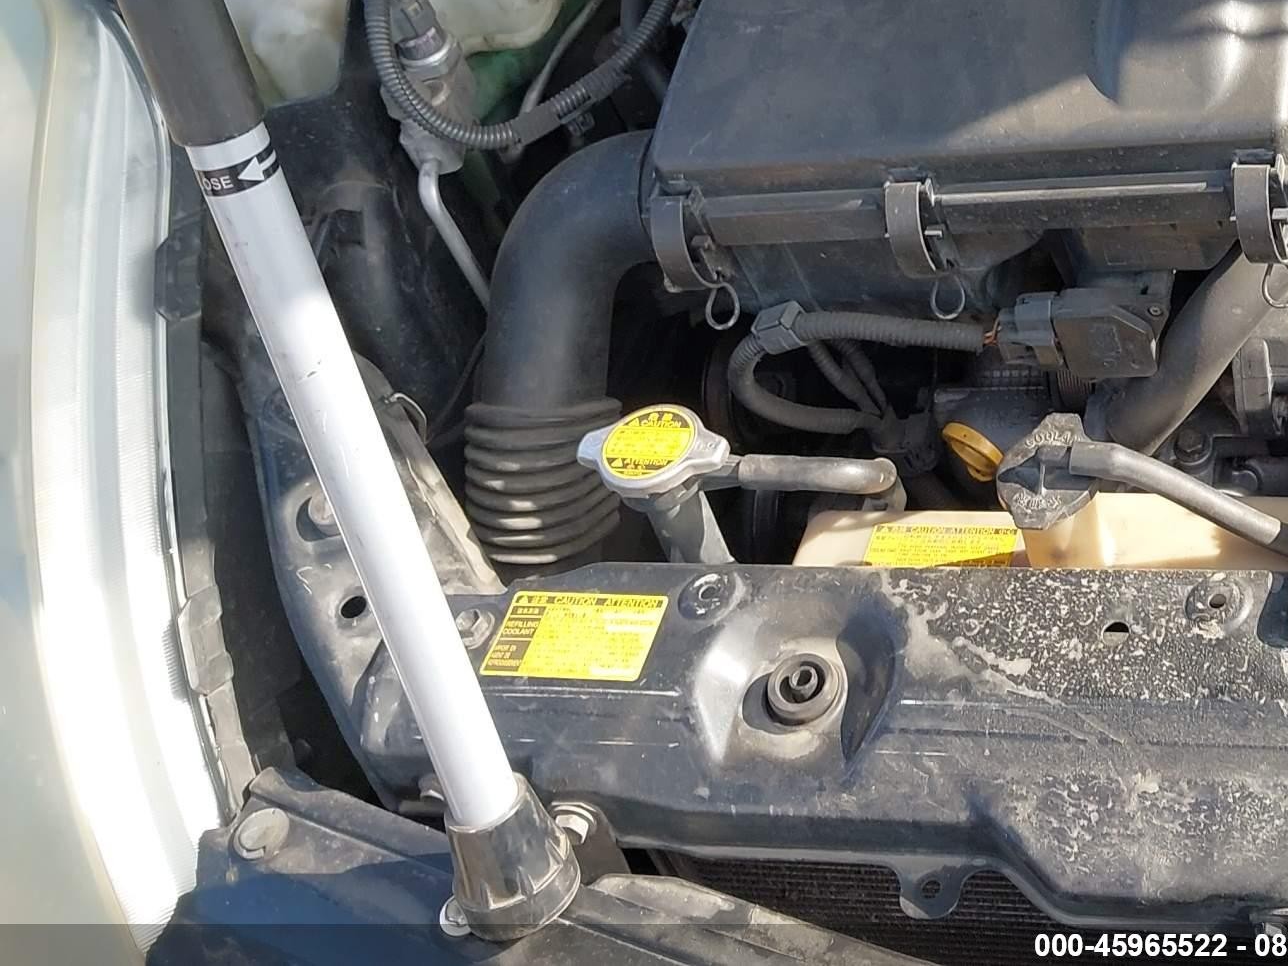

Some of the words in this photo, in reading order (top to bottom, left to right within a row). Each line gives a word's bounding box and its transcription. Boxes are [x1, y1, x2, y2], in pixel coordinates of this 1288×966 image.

[640, 419, 682, 428] CAUTION
[624, 457, 669, 466] ATTENTION
[911, 527, 944, 535] CAUTION
[951, 527, 994, 535] ATTENTION
[554, 596, 596, 606] CAUTION
[603, 598, 658, 608] ATTENTION
